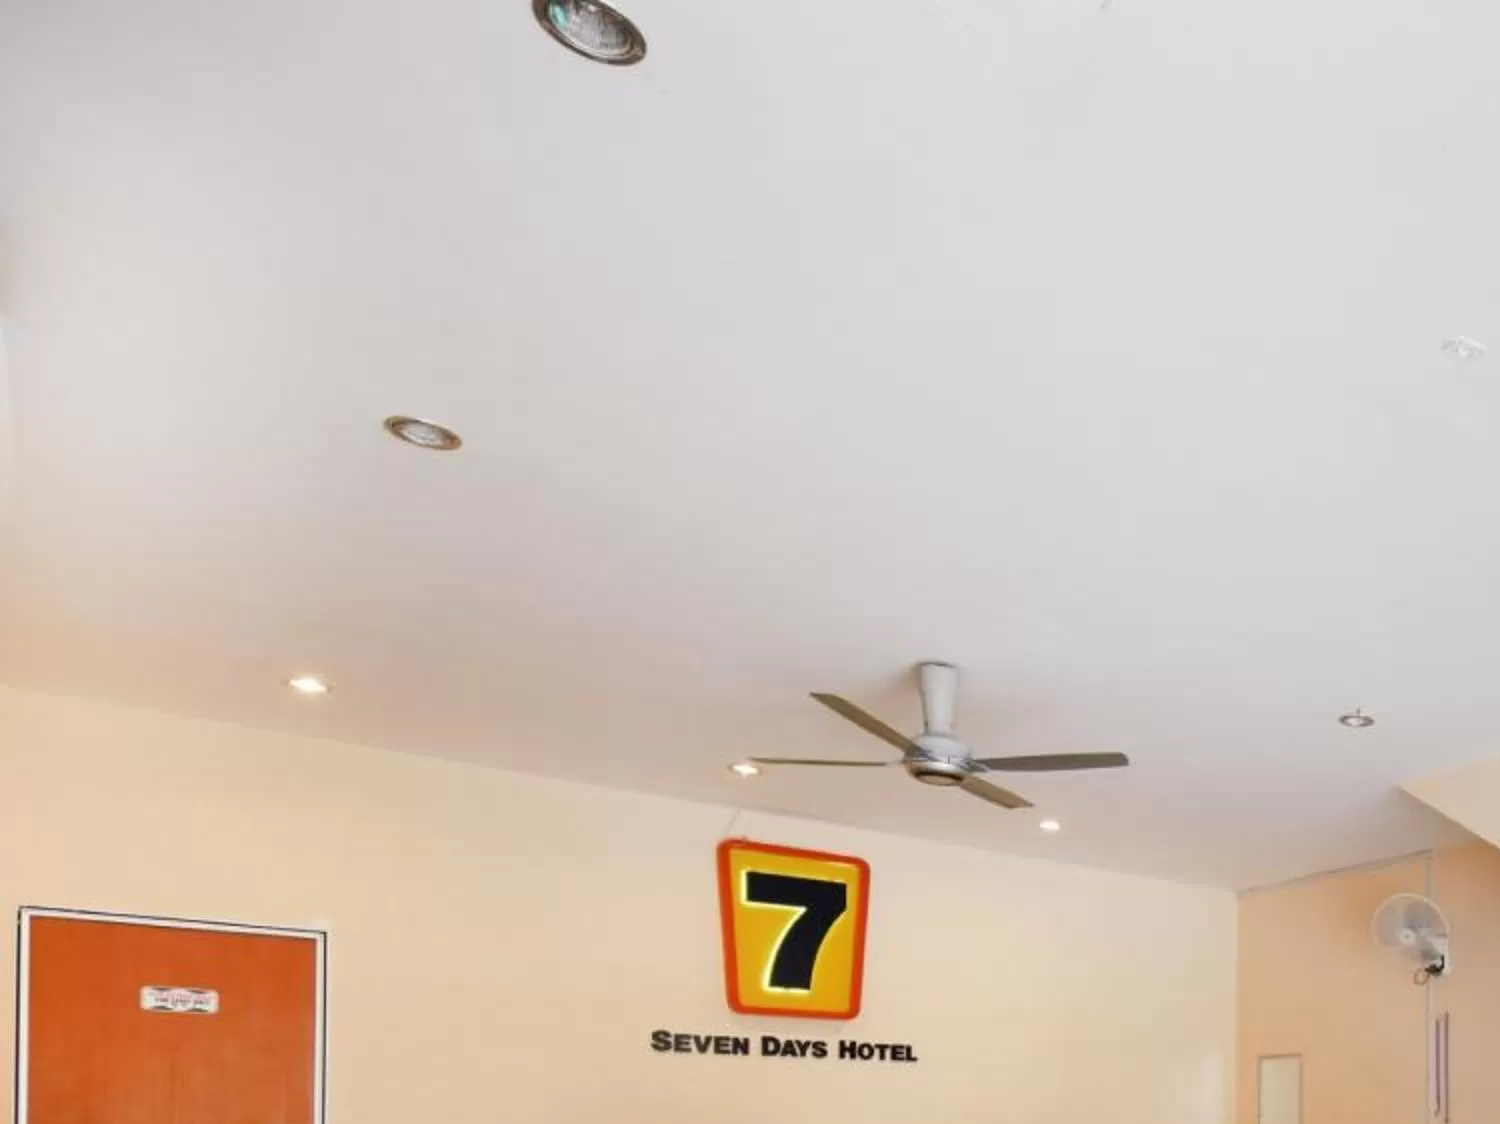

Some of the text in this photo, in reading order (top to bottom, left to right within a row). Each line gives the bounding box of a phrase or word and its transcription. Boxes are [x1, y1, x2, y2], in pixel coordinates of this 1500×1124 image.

[744, 868, 848, 991] 7
[650, 1029, 918, 1063] SEVEN DAYS HOTEL
